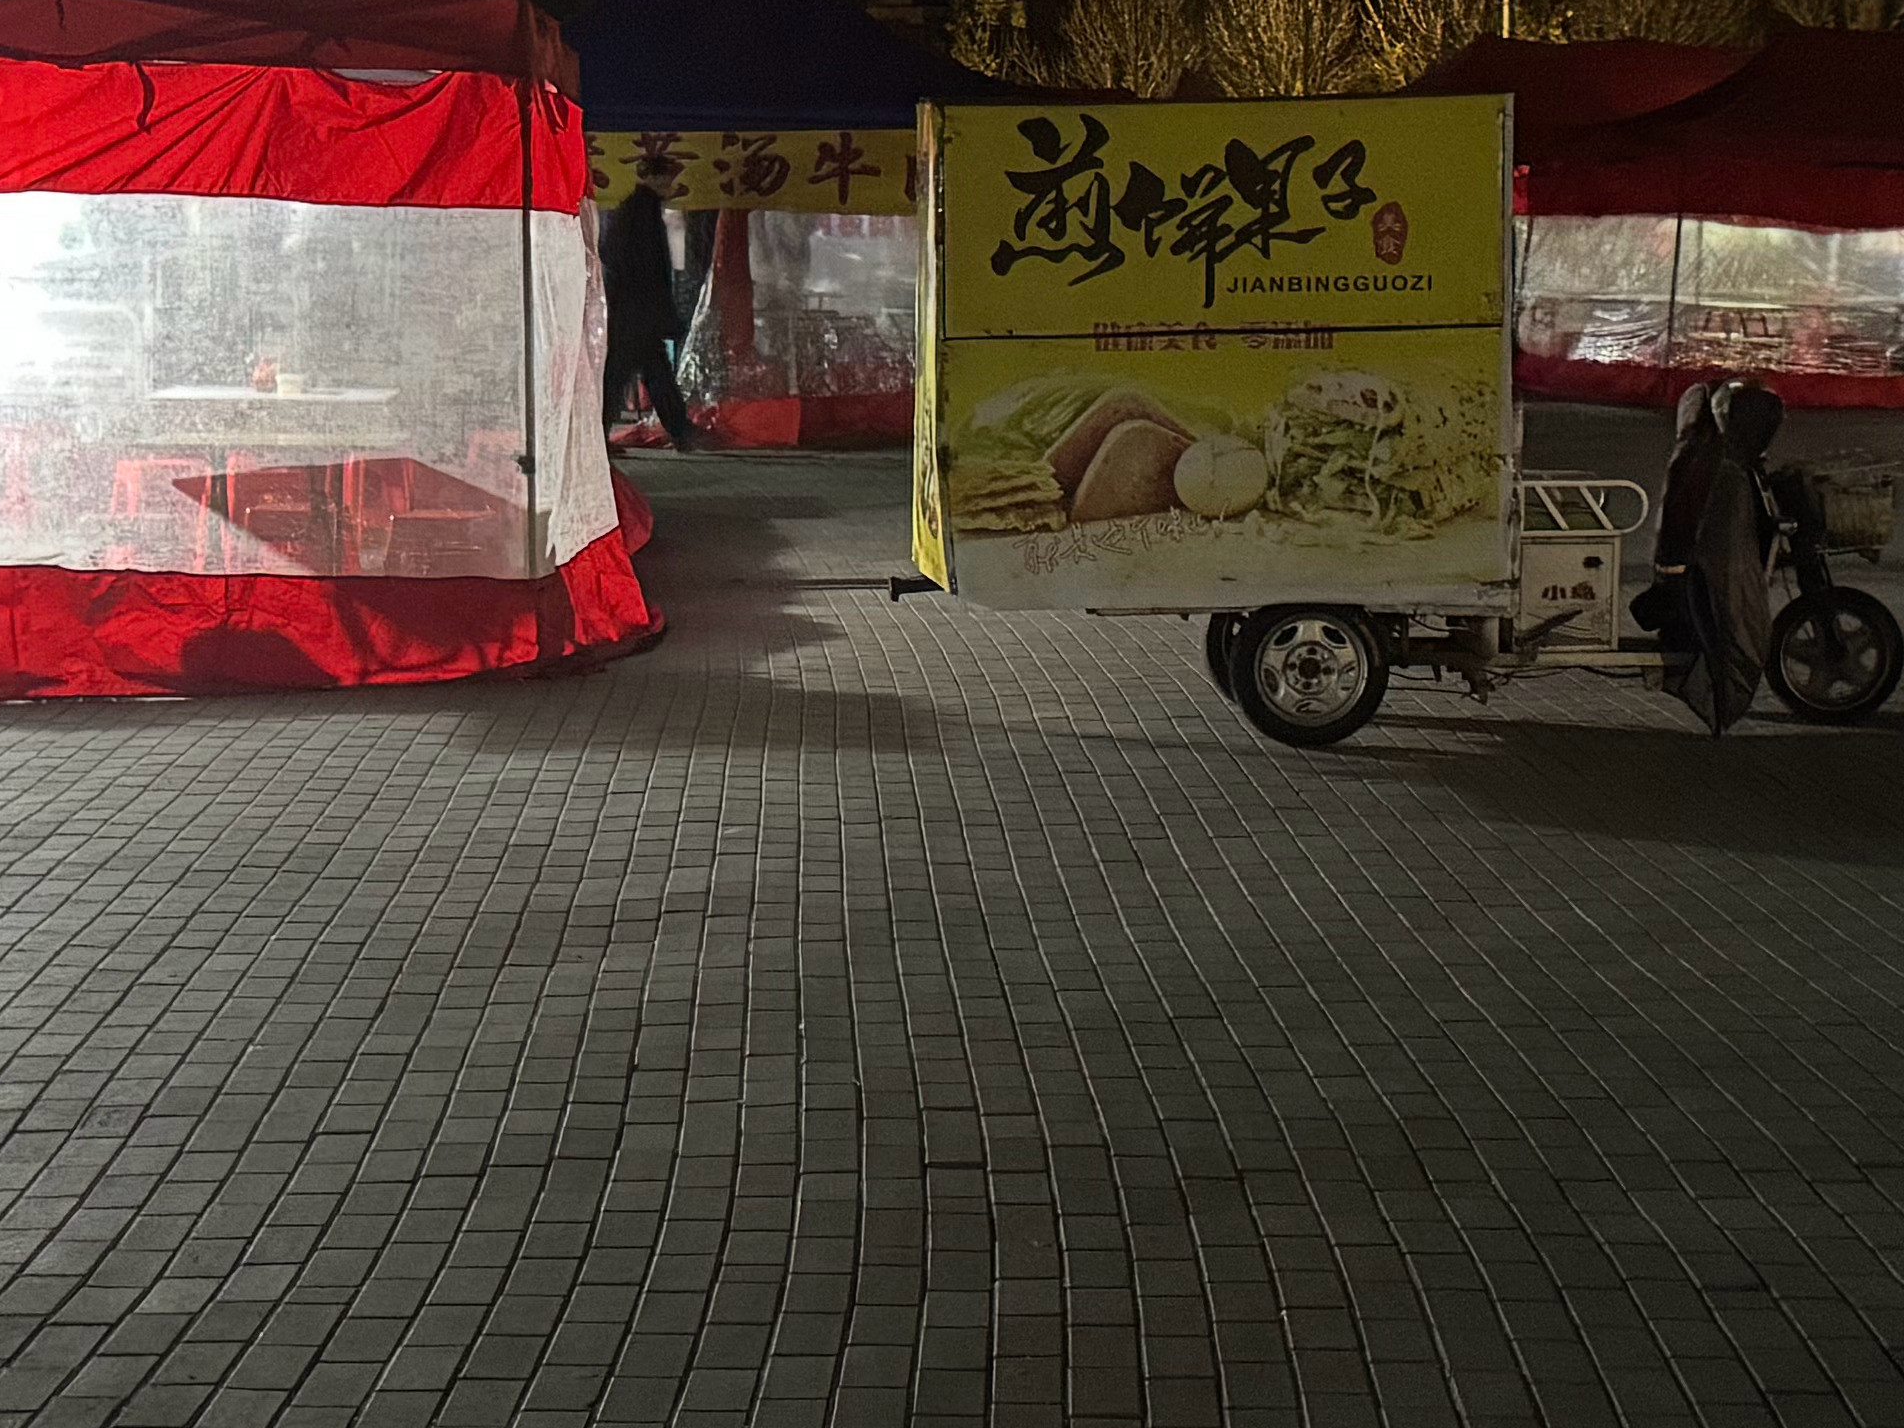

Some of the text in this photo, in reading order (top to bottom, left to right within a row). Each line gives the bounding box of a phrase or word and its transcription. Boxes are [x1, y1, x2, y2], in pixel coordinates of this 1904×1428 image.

[991, 113, 1377, 308] 煎饼果子
[1226, 274, 1433, 294] JIANBINGGUOZI
